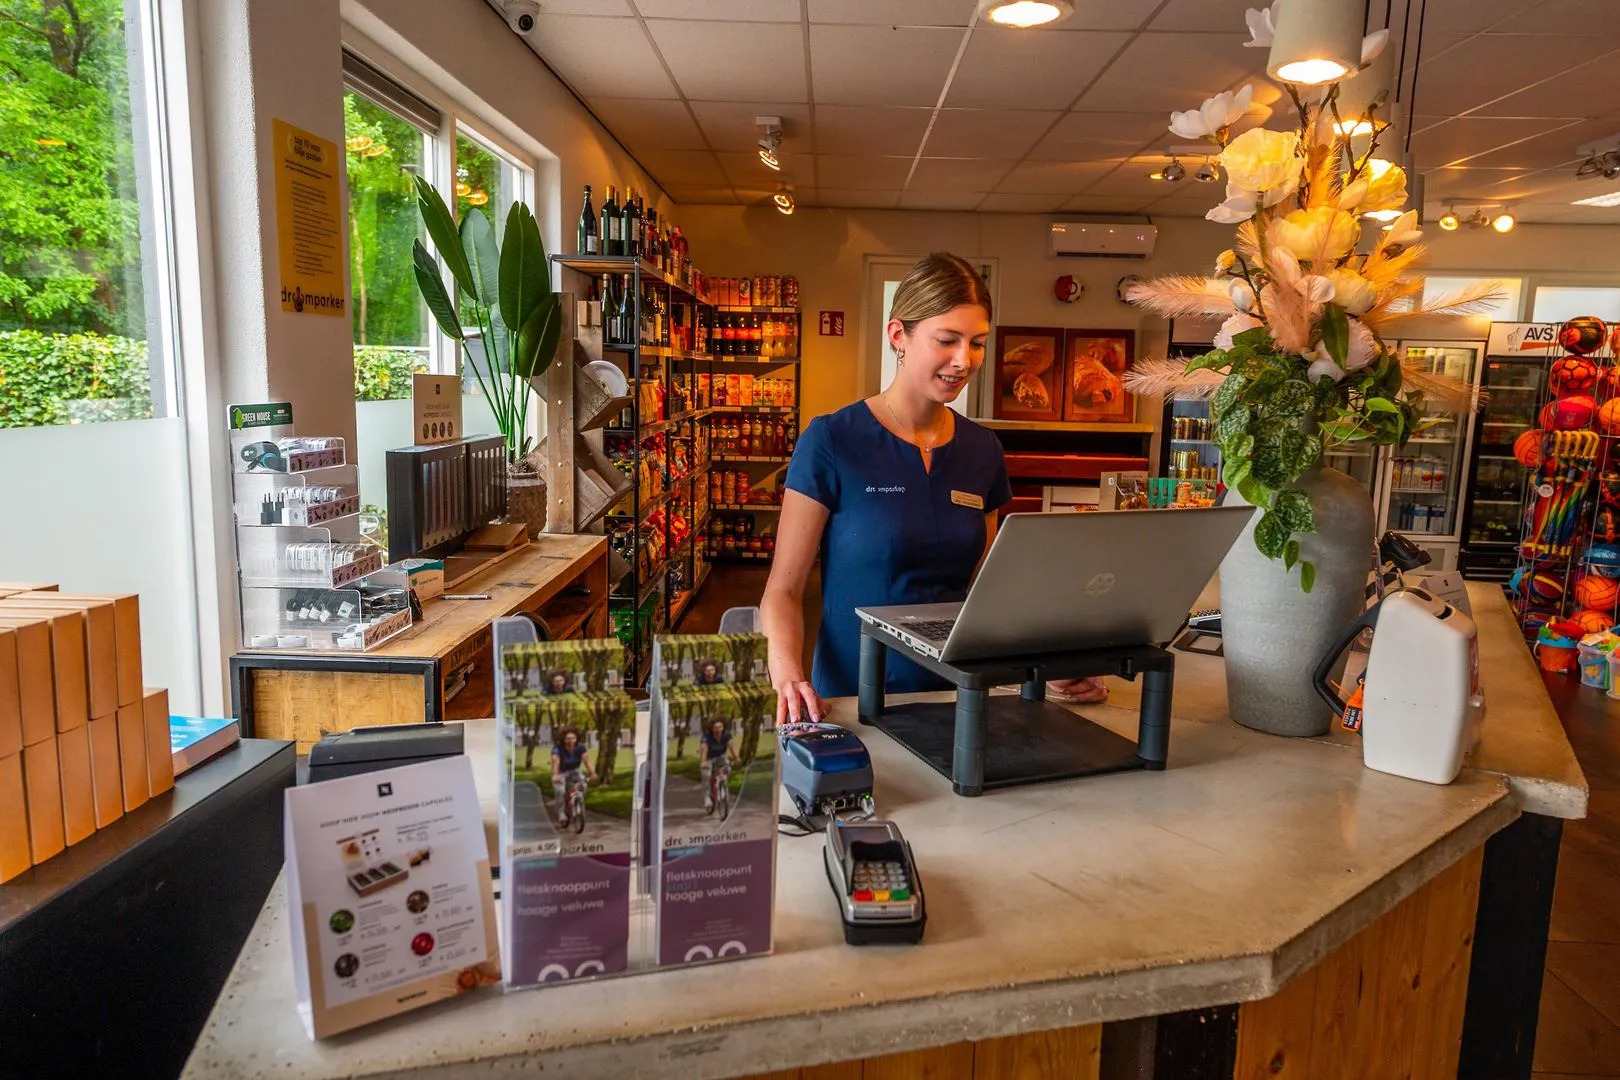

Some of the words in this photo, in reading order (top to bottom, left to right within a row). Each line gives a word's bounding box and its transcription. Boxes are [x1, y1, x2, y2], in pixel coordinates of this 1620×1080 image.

[1524, 327, 1554, 341] AVS
[666, 864, 752, 883] fietsknooppunt
[517, 879, 611, 895] fietsknooppunt
[666, 889, 704, 902] hooge
[706, 884, 747, 897] veluwe
